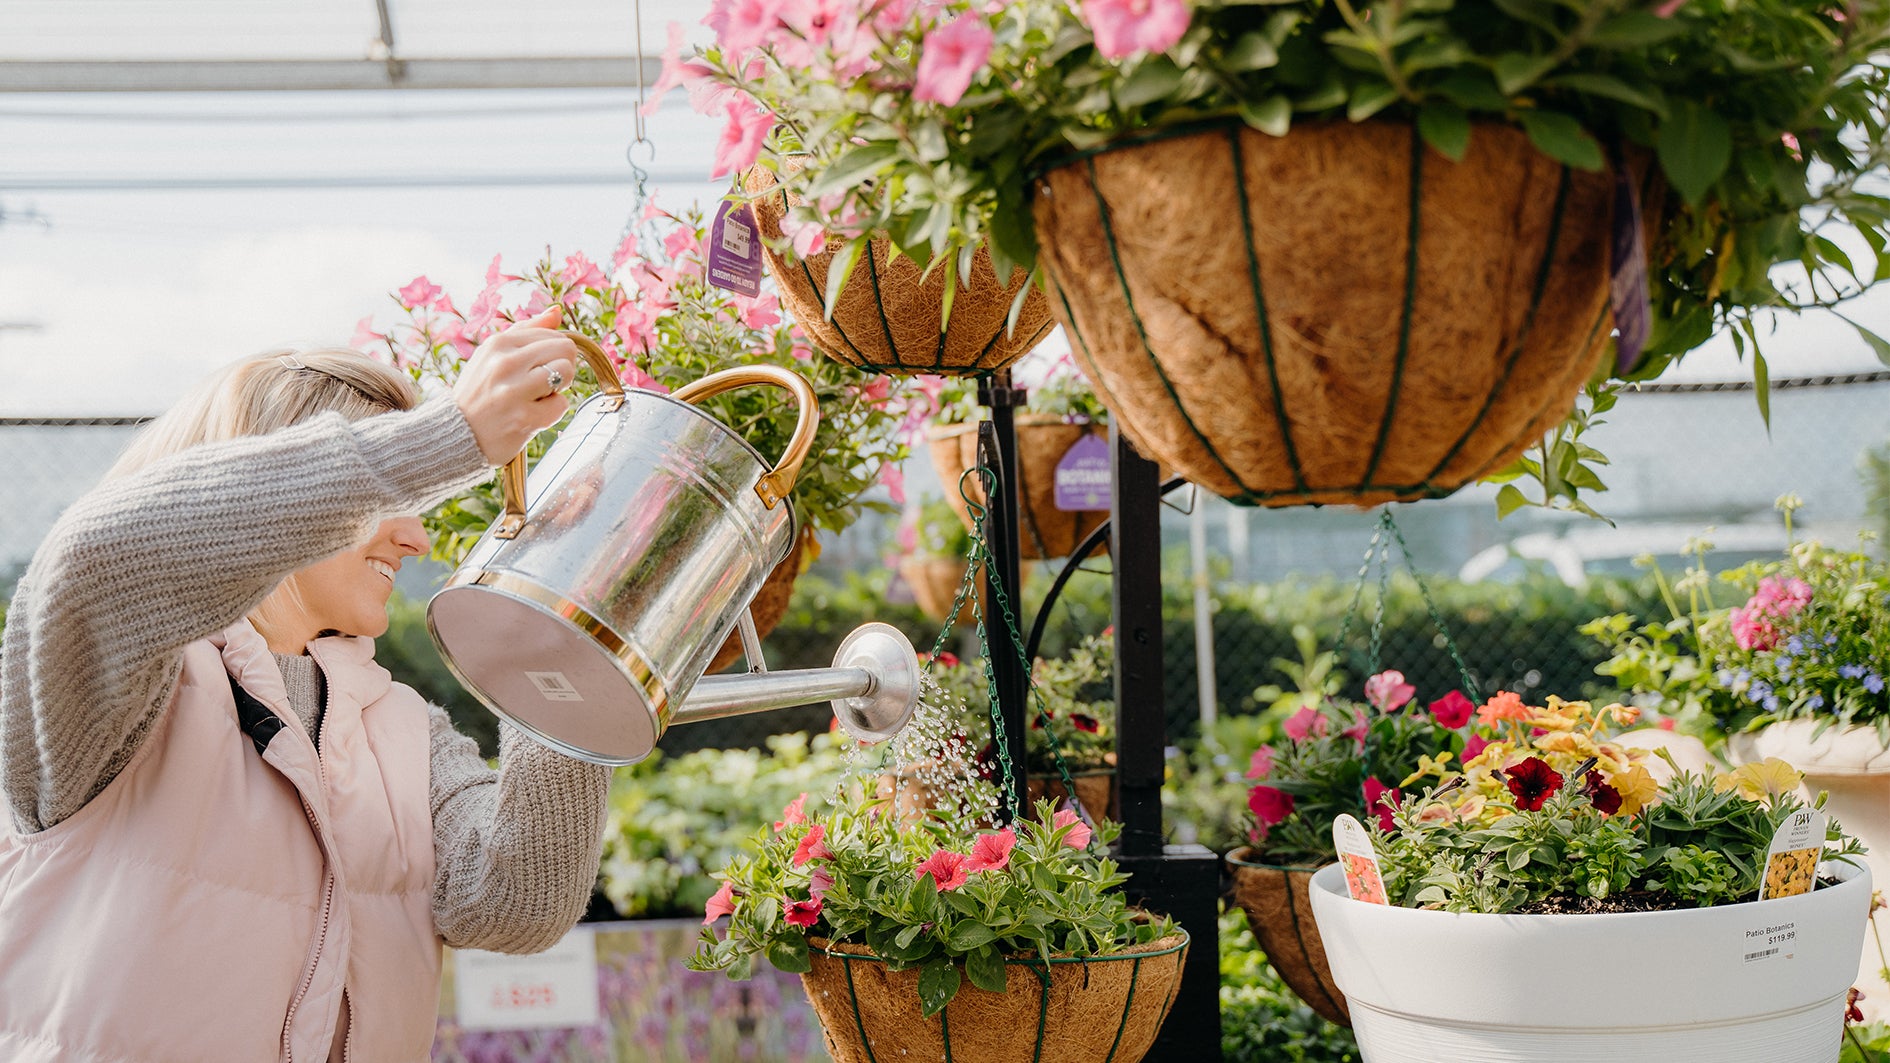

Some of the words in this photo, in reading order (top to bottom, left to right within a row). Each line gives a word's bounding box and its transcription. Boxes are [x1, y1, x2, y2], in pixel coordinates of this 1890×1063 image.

[711, 268, 731, 283] GARDENS
[741, 278, 756, 290] READY
[1745, 929, 1765, 938] Patio
[1766, 922, 1795, 935] Botanics
[1768, 931, 1795, 945] $119.99
